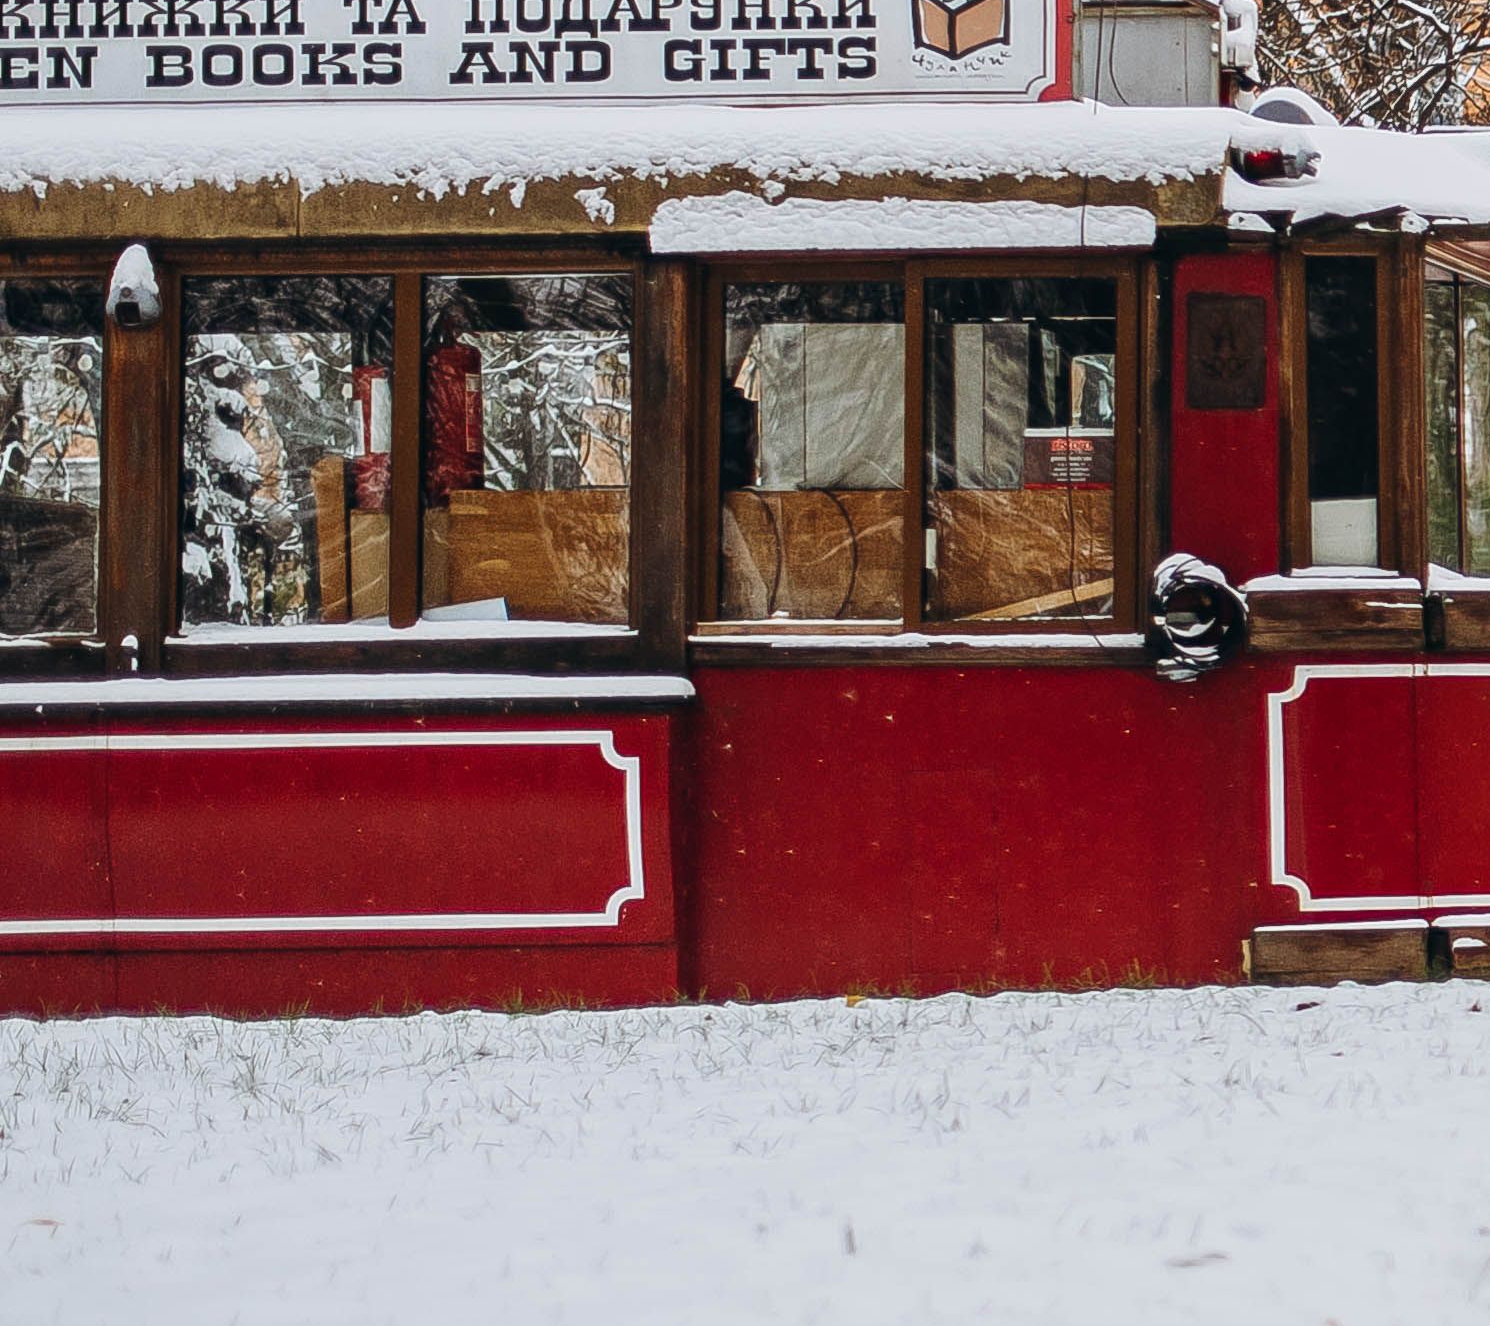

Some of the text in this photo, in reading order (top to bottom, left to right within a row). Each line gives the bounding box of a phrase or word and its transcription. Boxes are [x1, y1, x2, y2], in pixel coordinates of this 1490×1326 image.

[145, 43, 402, 88] BOOKS
[449, 40, 612, 85] AND
[663, 36, 877, 83] GIFTS
